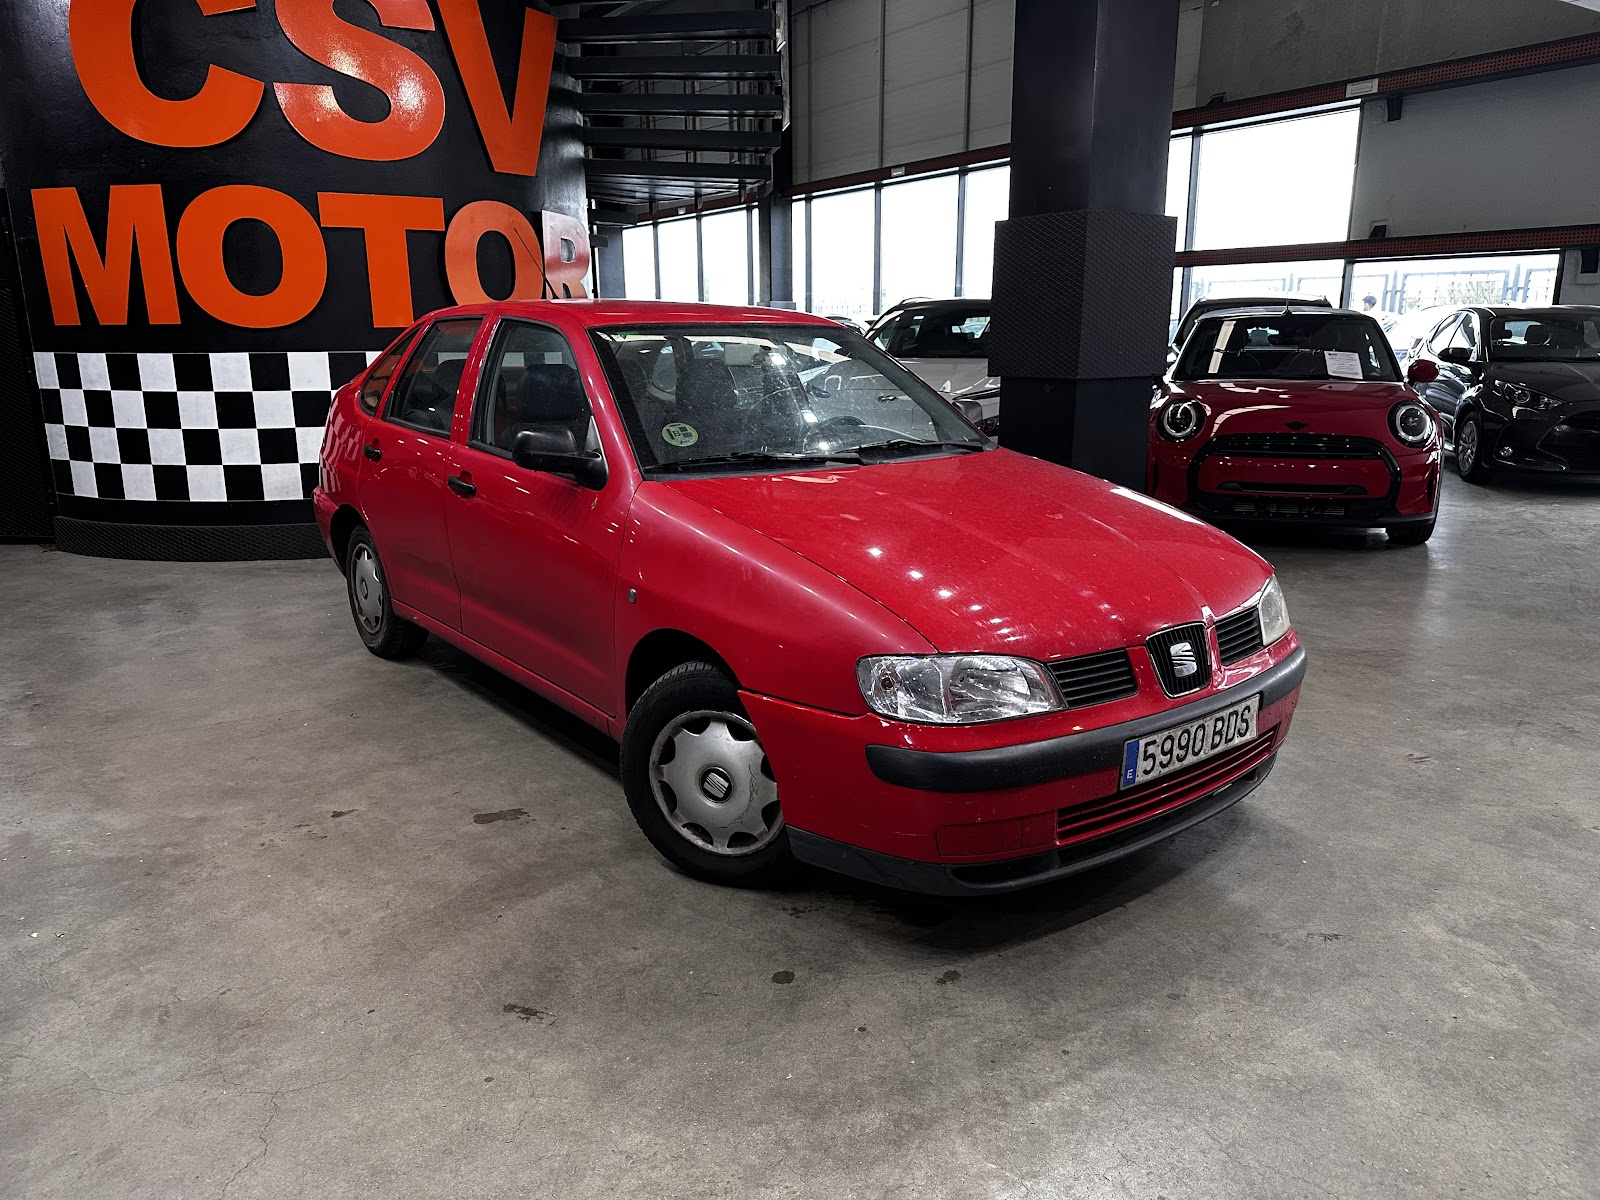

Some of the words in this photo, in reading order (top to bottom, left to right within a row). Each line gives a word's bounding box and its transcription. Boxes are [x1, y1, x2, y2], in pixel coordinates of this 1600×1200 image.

[69, 0, 558, 177] CSV
[31, 184, 590, 328] MOTOR
[1142, 724, 1206, 775] 5990
[1210, 705, 1251, 751] BDS
